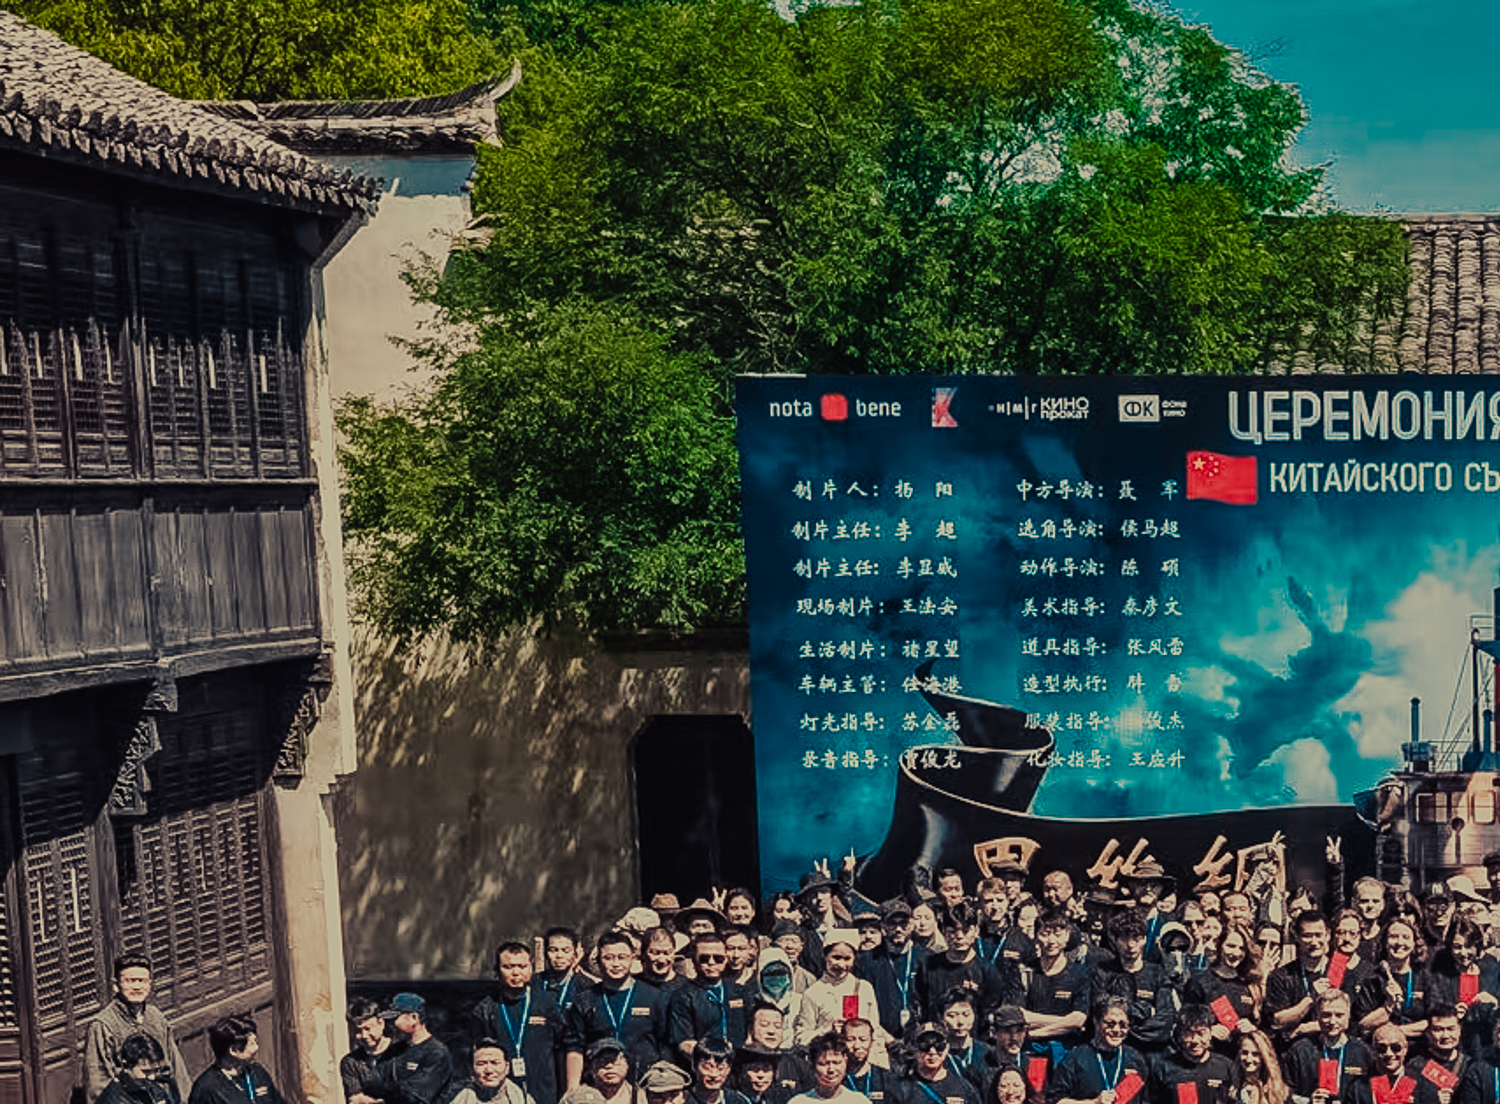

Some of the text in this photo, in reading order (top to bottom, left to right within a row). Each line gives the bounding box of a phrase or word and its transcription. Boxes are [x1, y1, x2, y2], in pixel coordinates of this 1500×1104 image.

[769, 399, 902, 418] nota bene
[1040, 396, 1089, 411] КИНО
[1040, 409, 1089, 422] прокат
[1269, 458, 1453, 493] КИТАЙСКОГО
[792, 479, 879, 501] 制片人：
[1016, 479, 1103, 501] 中方导演：
[791, 519, 880, 541] 制片主任：
[793, 557, 879, 579] 制片主任：
[1019, 557, 1104, 577] 动作导演：
[800, 711, 884, 731] 灯光指导：
